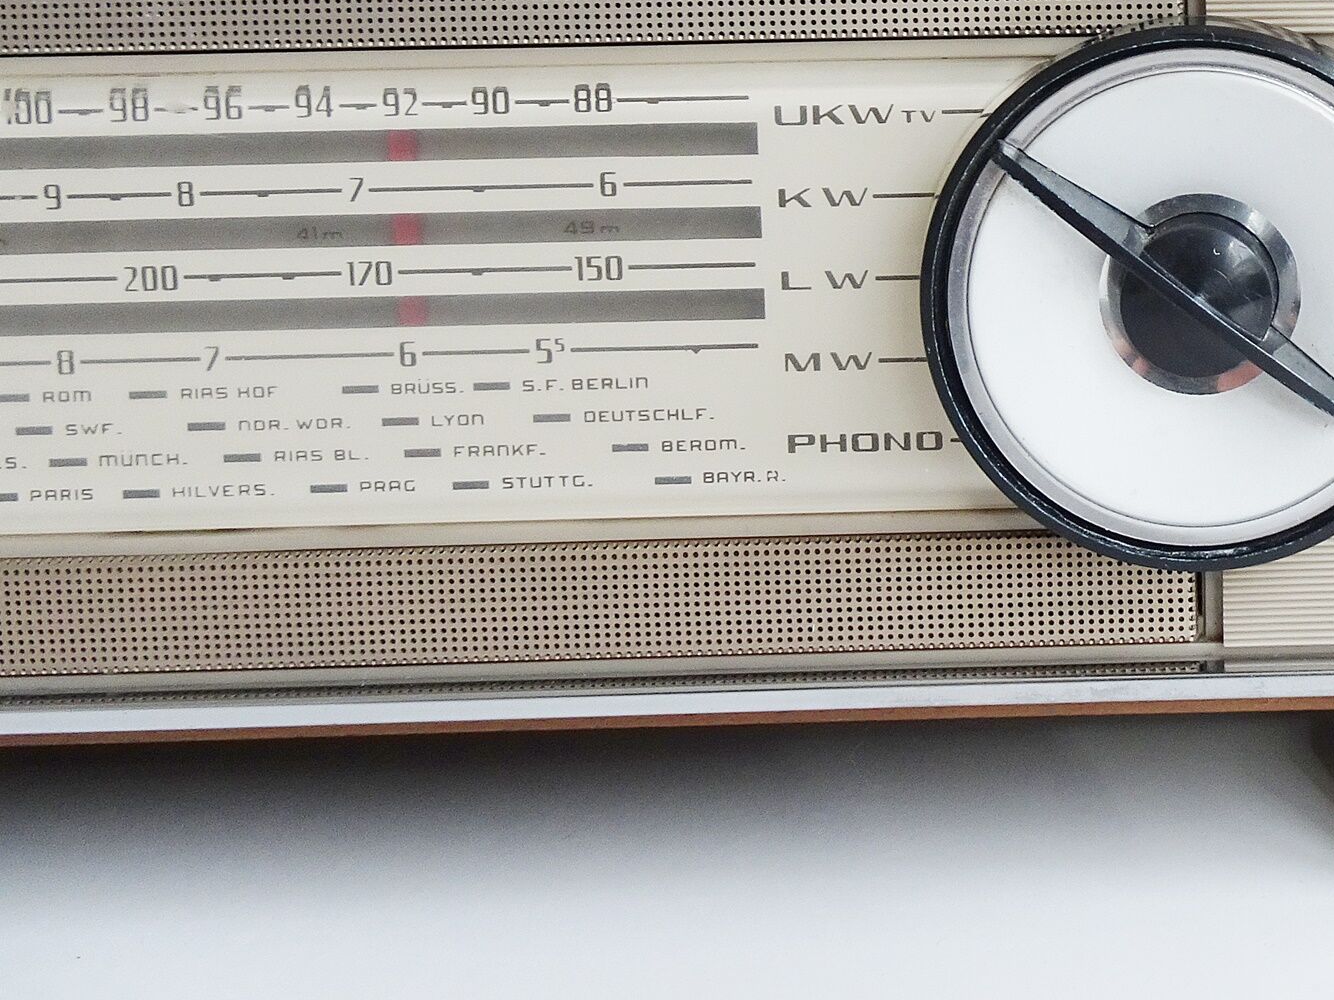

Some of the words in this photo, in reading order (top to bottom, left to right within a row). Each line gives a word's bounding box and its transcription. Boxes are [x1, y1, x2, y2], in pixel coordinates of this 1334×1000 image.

[108, 81, 153, 123] 98
[202, 84, 243, 121] 96
[294, 79, 335, 119] 94
[382, 87, 419, 117] 92
[470, 85, 511, 116] 90
[573, 79, 616, 113] 88
[773, 103, 895, 127] UKW
[900, 109, 937, 124] TV
[42, 183, 63, 211] 9
[176, 180, 196, 208] 8
[348, 177, 364, 203] 7
[599, 171, 618, 198] 6
[123, 264, 179, 293] 200
[346, 260, 393, 287] 170
[570, 255, 624, 282] 150
[56, 349, 76, 376] 8
[204, 345, 220, 372] 7
[399, 340, 417, 368] 6
[390, 378, 465, 395] BRÜSS.
[522, 378, 565, 393] S.F.
[571, 376, 649, 391] BERLIN
[42, 389, 92, 403] ROM
[180, 386, 229, 400] RIAS
[237, 385, 278, 399] HOF
[431, 413, 485, 427] LYON
[583, 407, 715, 424] DEUTSCHLF.
[65, 422, 123, 437] SWF.
[661, 438, 747, 453] BEROM.
[787, 430, 944, 454] PHONO
[273, 449, 323, 463] RIAS
[333, 448, 369, 462] BL.
[453, 443, 547, 458] FRANKF.
[359, 479, 416, 493] PRAG
[501, 474, 594, 490] STUTTG.
[29, 488, 94, 502] PARIS
[171, 483, 275, 498] HILVERS.
